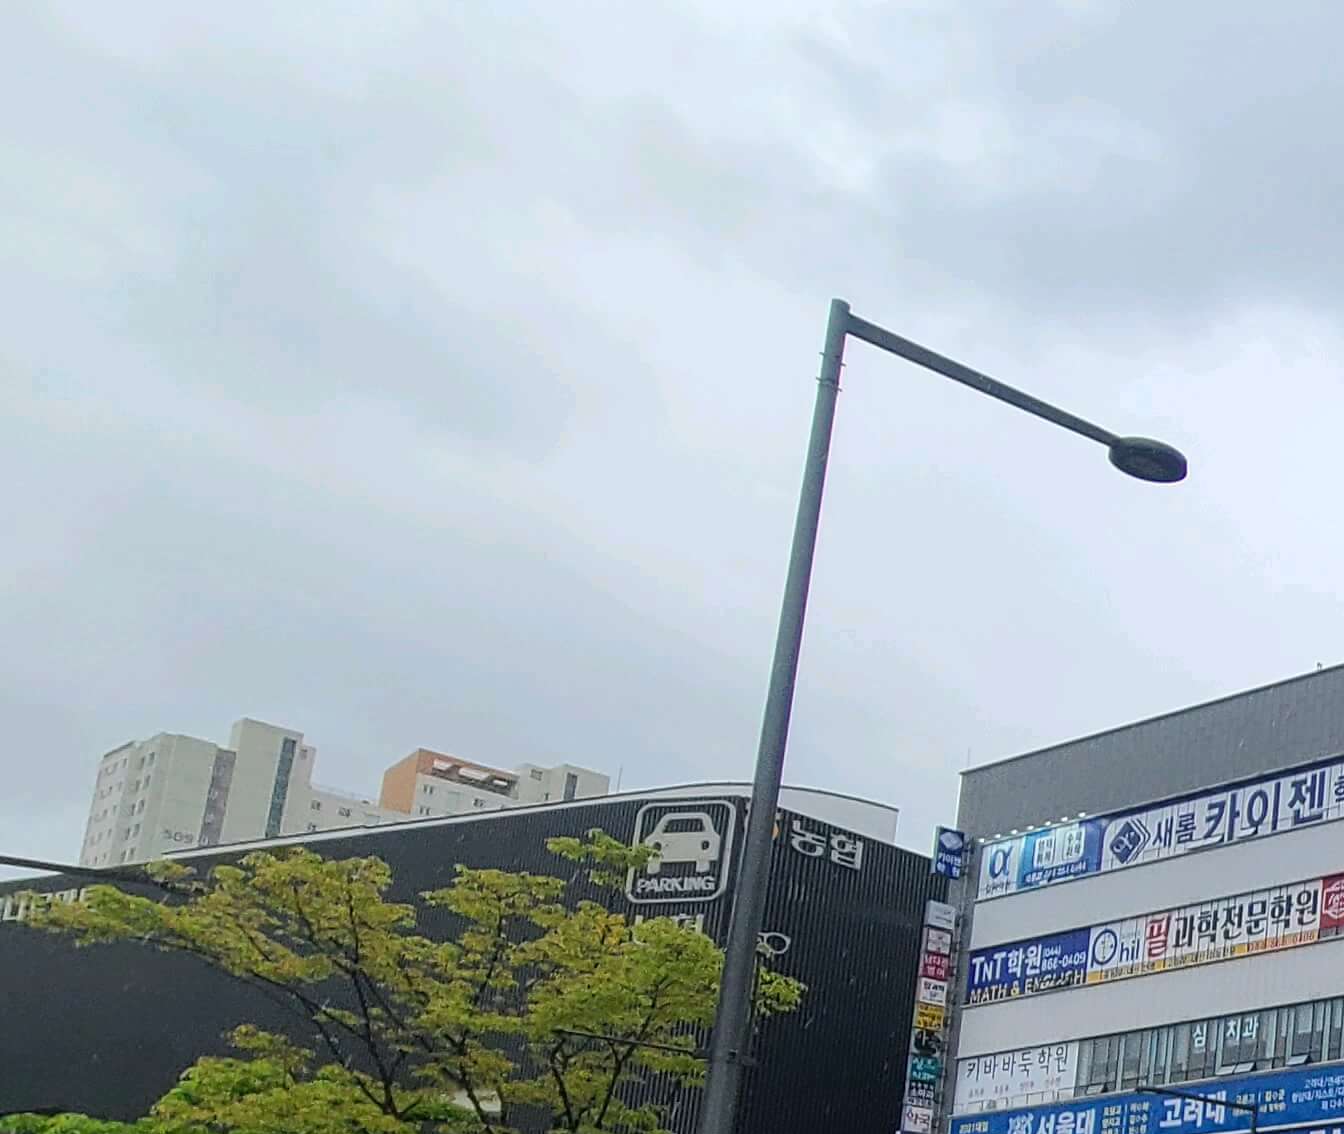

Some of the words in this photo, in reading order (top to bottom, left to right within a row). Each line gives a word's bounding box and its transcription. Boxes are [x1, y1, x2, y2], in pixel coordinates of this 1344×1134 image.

[1152, 813, 1198, 848] 새롬
[1203, 770, 1327, 845] 카이젠
[791, 820, 864, 871] 농협
[636, 876, 717, 895] PARKING
[969, 982, 1008, 1005] MATH
